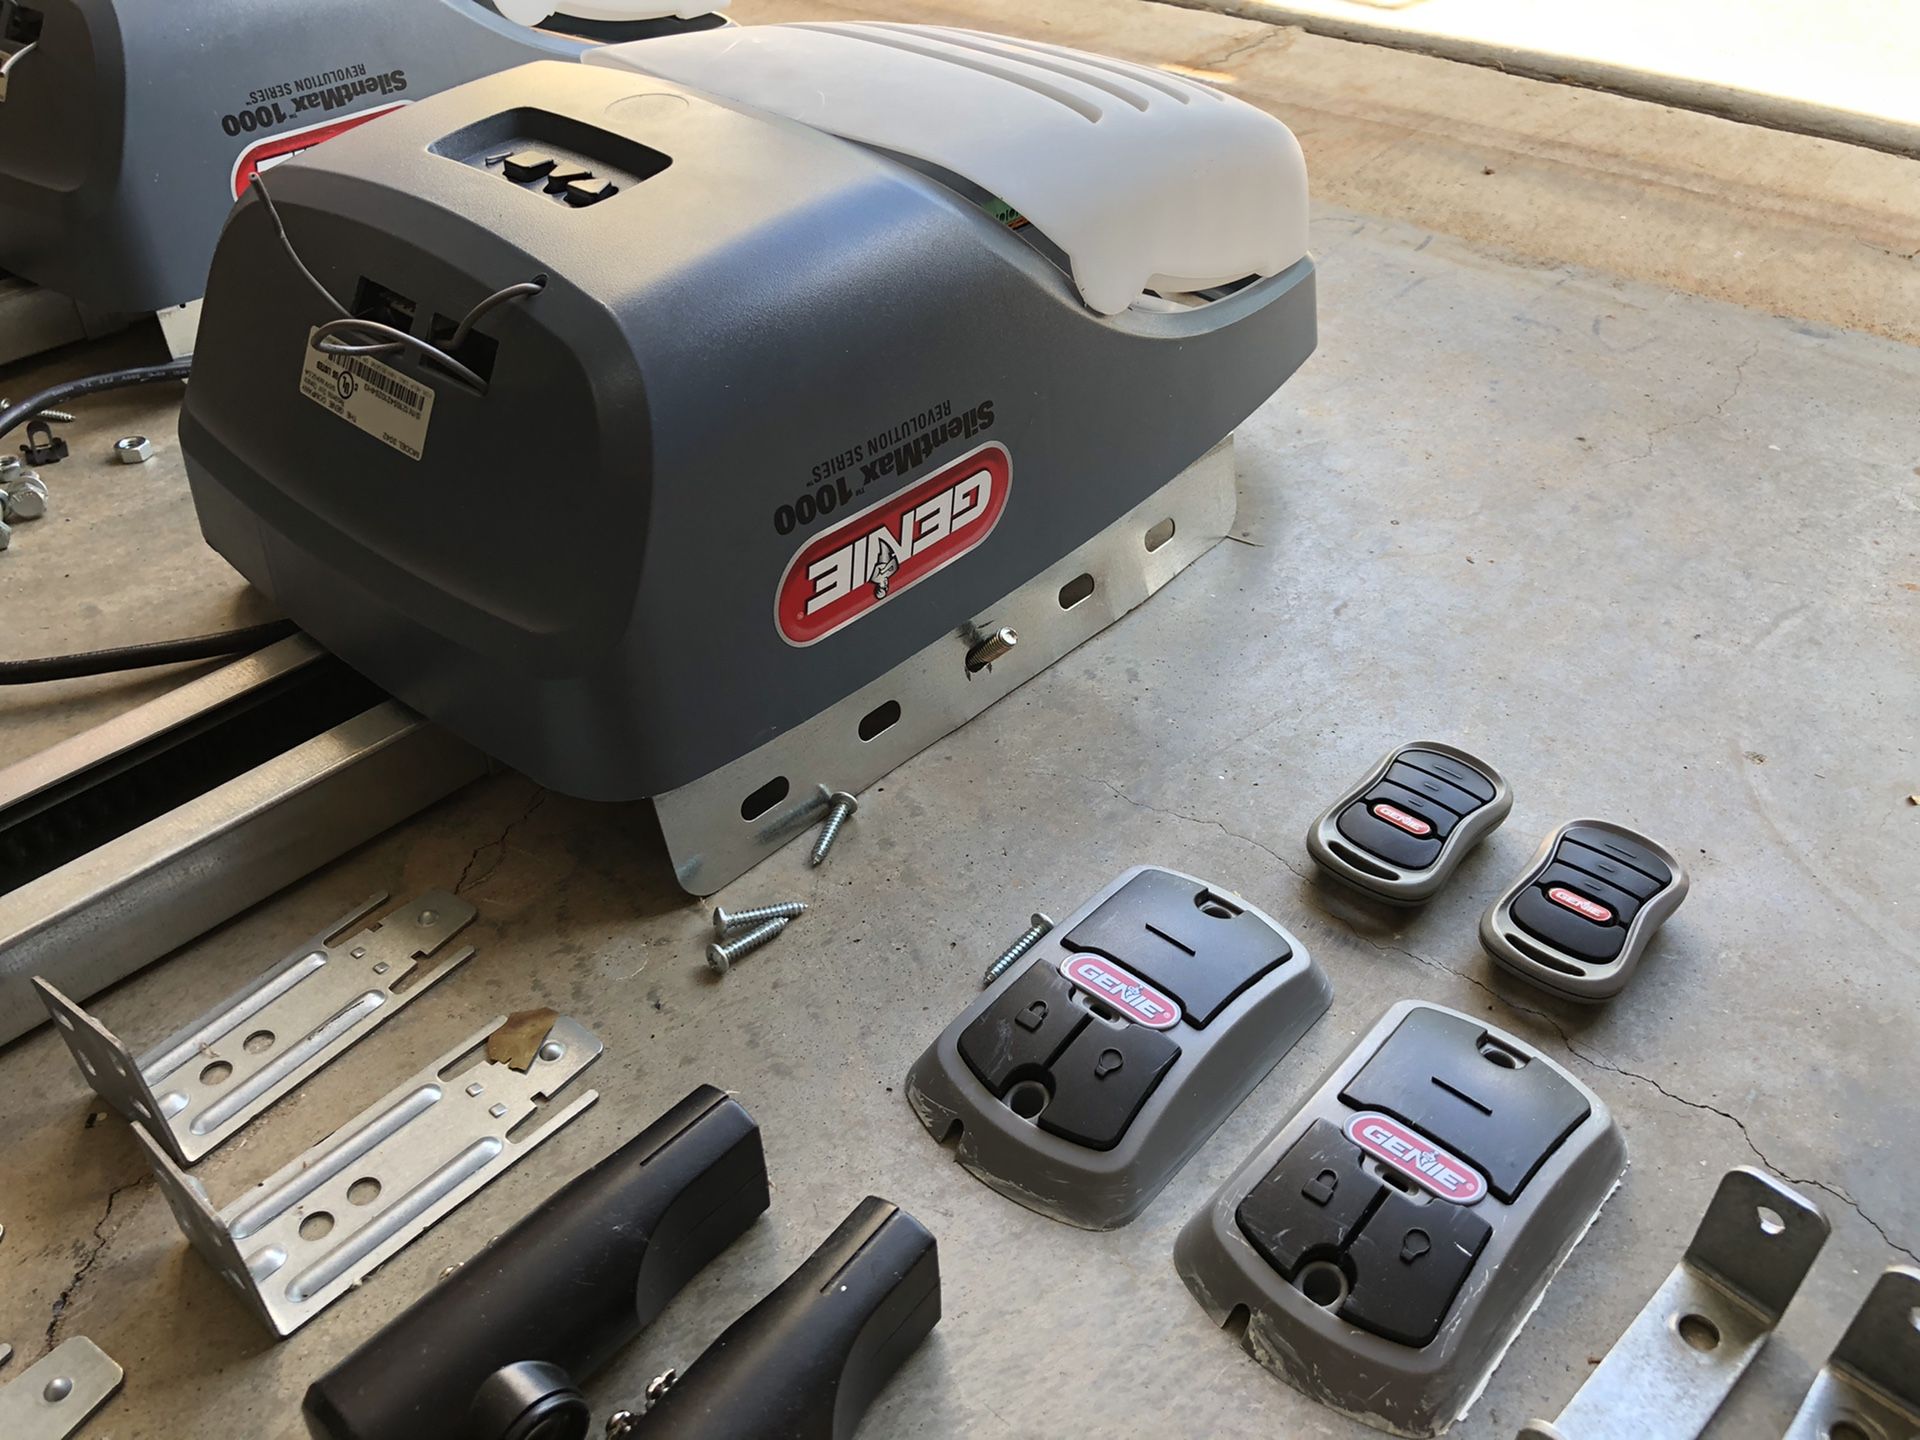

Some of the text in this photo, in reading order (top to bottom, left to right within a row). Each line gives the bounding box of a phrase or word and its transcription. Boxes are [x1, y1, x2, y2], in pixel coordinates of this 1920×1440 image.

[250, 63, 366, 103] REVOLUTION SERIES
[291, 70, 407, 113] SilentMax
[222, 103, 287, 137] 1000
[861, 400, 995, 485] SilentMax
[867, 400, 952, 455] REVOLUTION
[812, 445, 864, 483] SERIES
[774, 476, 853, 536] 1000
[807, 469, 993, 616] GENIE
[1380, 807, 1424, 831] GENIE
[1555, 891, 1604, 917] GENIE
[1077, 963, 1166, 1019] GENIE
[1362, 1124, 1467, 1191] GENIE
